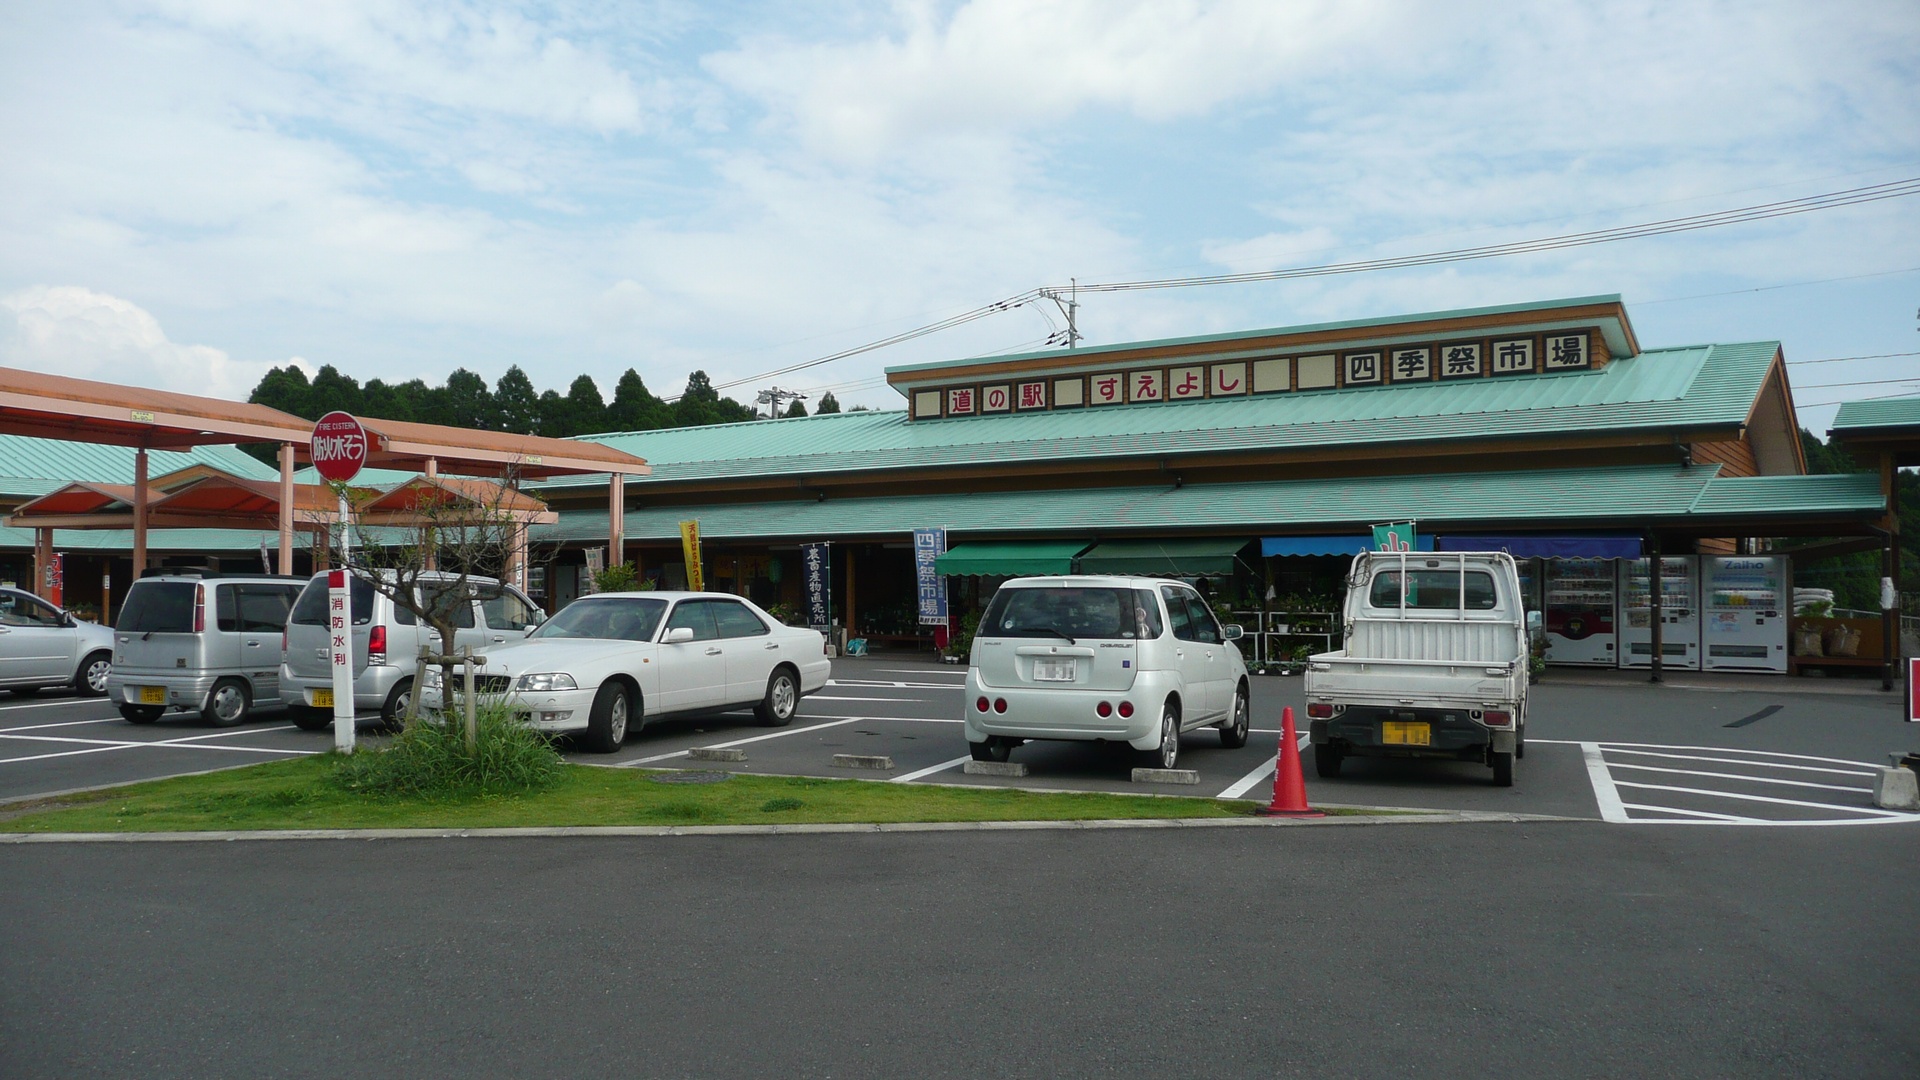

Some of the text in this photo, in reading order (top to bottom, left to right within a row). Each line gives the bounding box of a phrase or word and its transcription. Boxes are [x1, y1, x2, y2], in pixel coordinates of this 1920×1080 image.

[952, 337, 1582, 413] 道の駅 すえよし 四季祭市場
[319, 421, 356, 431] FIRE CISTERN
[807, 547, 826, 624] 農畜産物直売所
[917, 533, 938, 615] 四季祭市場
[1725, 560, 1764, 570] Zaiho
[331, 597, 346, 666] 消防水利
